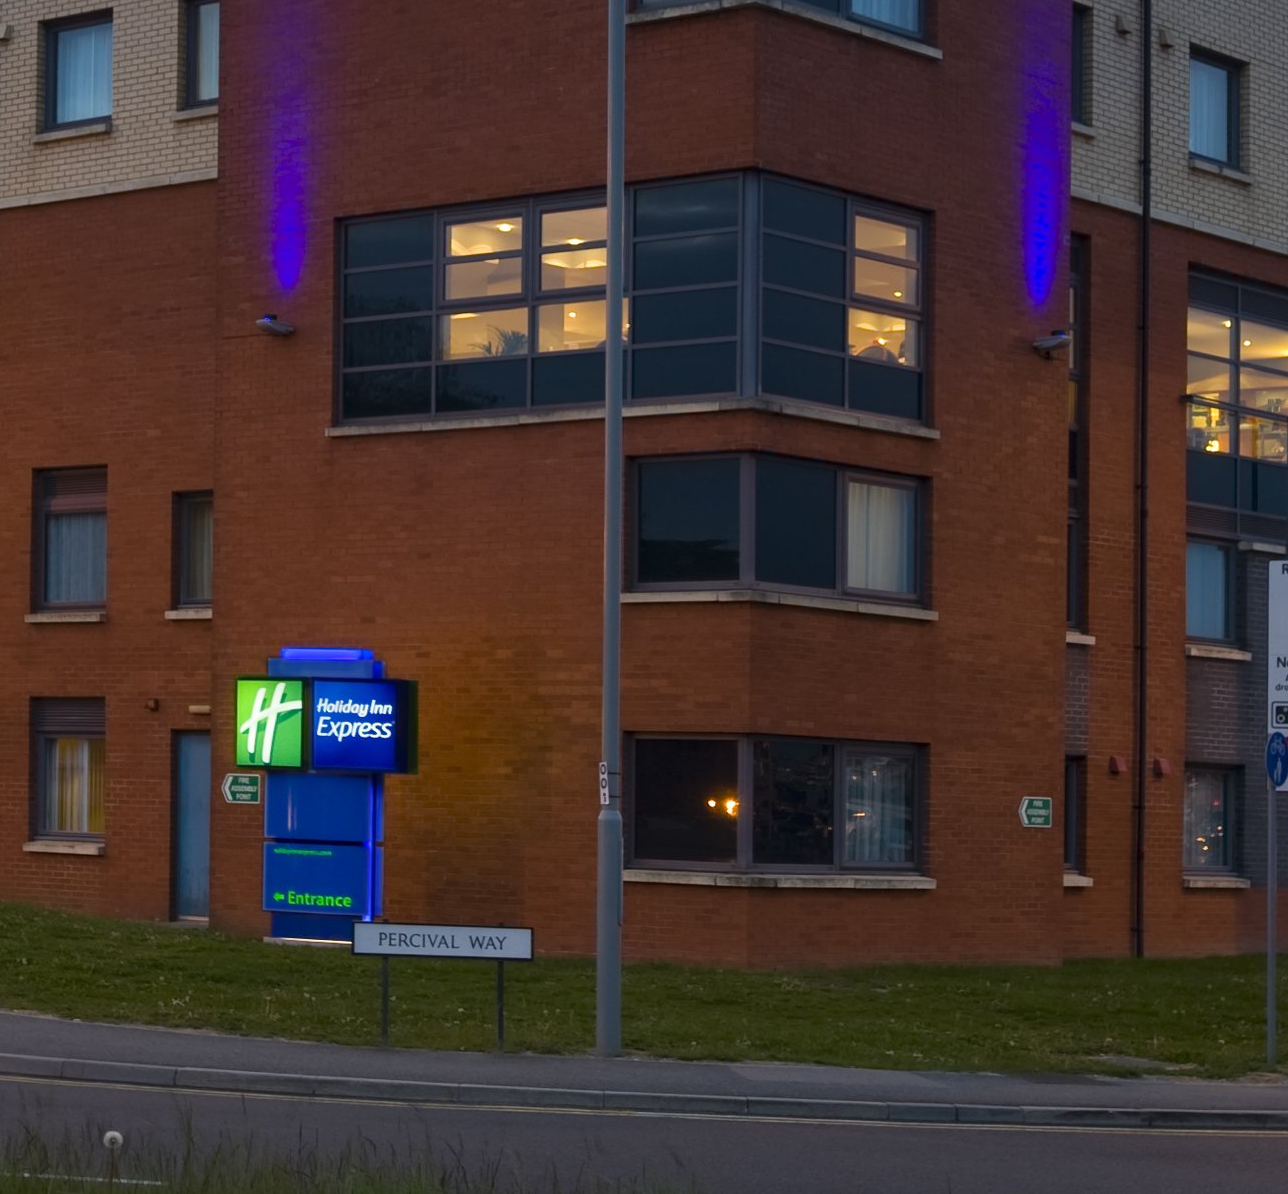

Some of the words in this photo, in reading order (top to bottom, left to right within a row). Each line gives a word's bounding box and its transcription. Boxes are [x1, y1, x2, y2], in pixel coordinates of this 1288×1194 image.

[316, 697, 369, 718] Holiday
[369, 699, 393, 715] Inn
[316, 716, 393, 743] Express
[288, 890, 352, 908] Entrance
[378, 932, 460, 949] PERCIVAL
[468, 935, 508, 950] WAY
